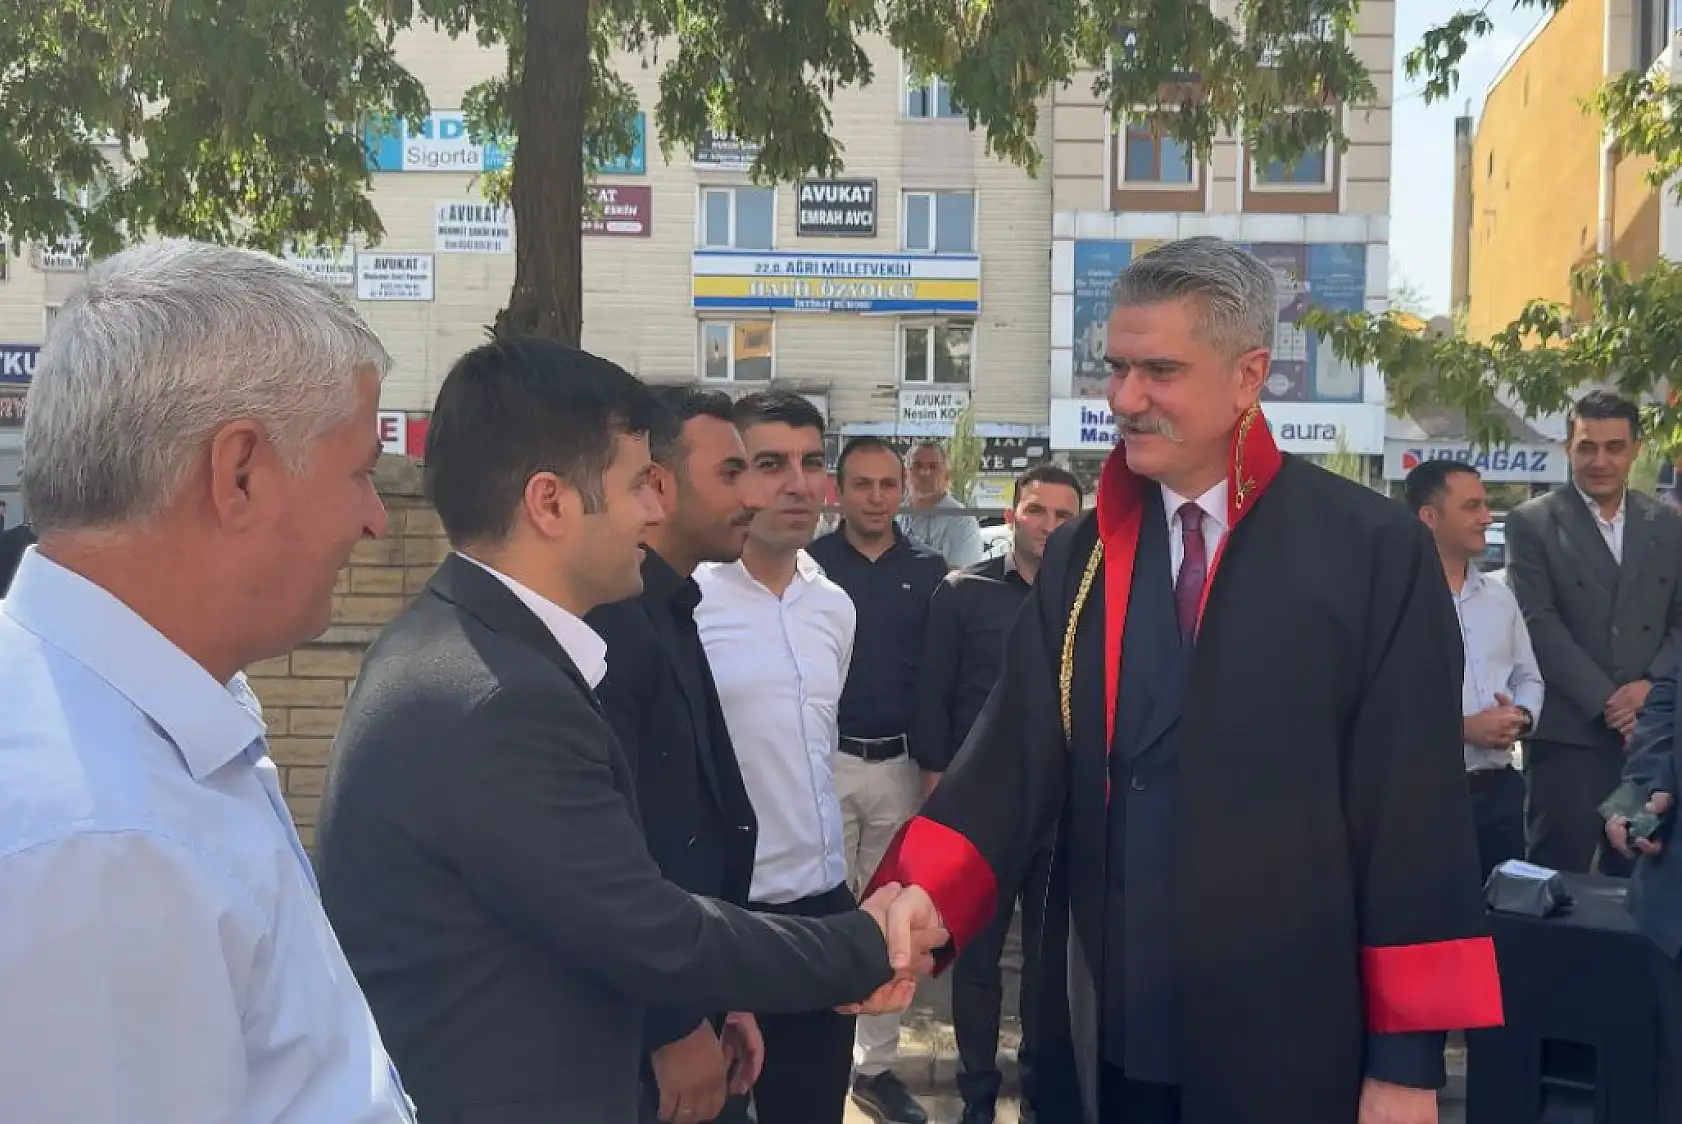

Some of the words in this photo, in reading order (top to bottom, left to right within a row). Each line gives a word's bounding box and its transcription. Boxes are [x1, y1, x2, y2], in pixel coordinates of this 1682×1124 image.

[407, 146, 479, 168] Sigorta
[801, 184, 873, 204] AVUKAT
[449, 204, 497, 223] AVUKAT
[801, 209, 844, 227] EMRAH
[845, 210, 874, 227] AVCI
[374, 258, 418, 271] AVUKAT
[785, 258, 819, 275] AĞRI
[822, 260, 912, 277] MİLLETVEKİLİ
[914, 393, 952, 406] AVUKAT
[903, 407, 938, 420] Nesim
[1281, 423, 1337, 441] aura
